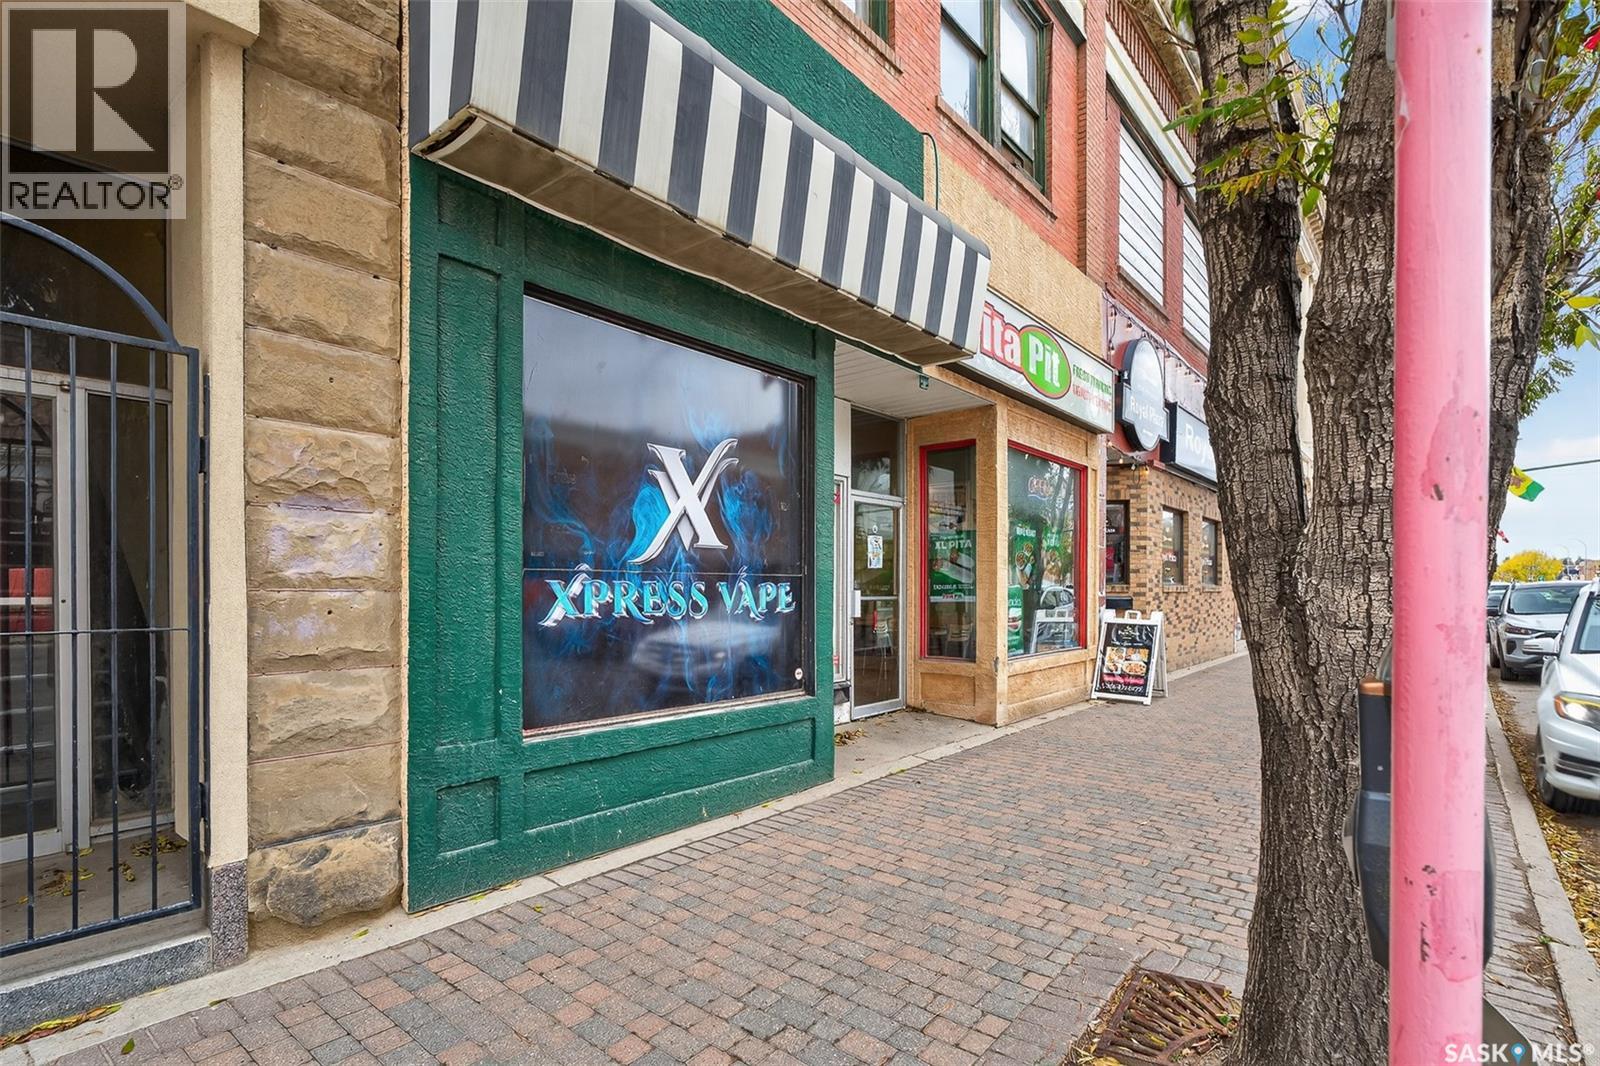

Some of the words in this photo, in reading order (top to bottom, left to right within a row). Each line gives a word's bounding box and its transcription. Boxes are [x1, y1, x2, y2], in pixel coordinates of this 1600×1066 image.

[981, 303, 1021, 368] ita
[1028, 333, 1061, 389] Pit
[626, 438, 740, 565] X
[948, 539, 973, 550] PITA
[538, 564, 709, 627] XPRESS
[716, 566, 797, 621] VAPE
